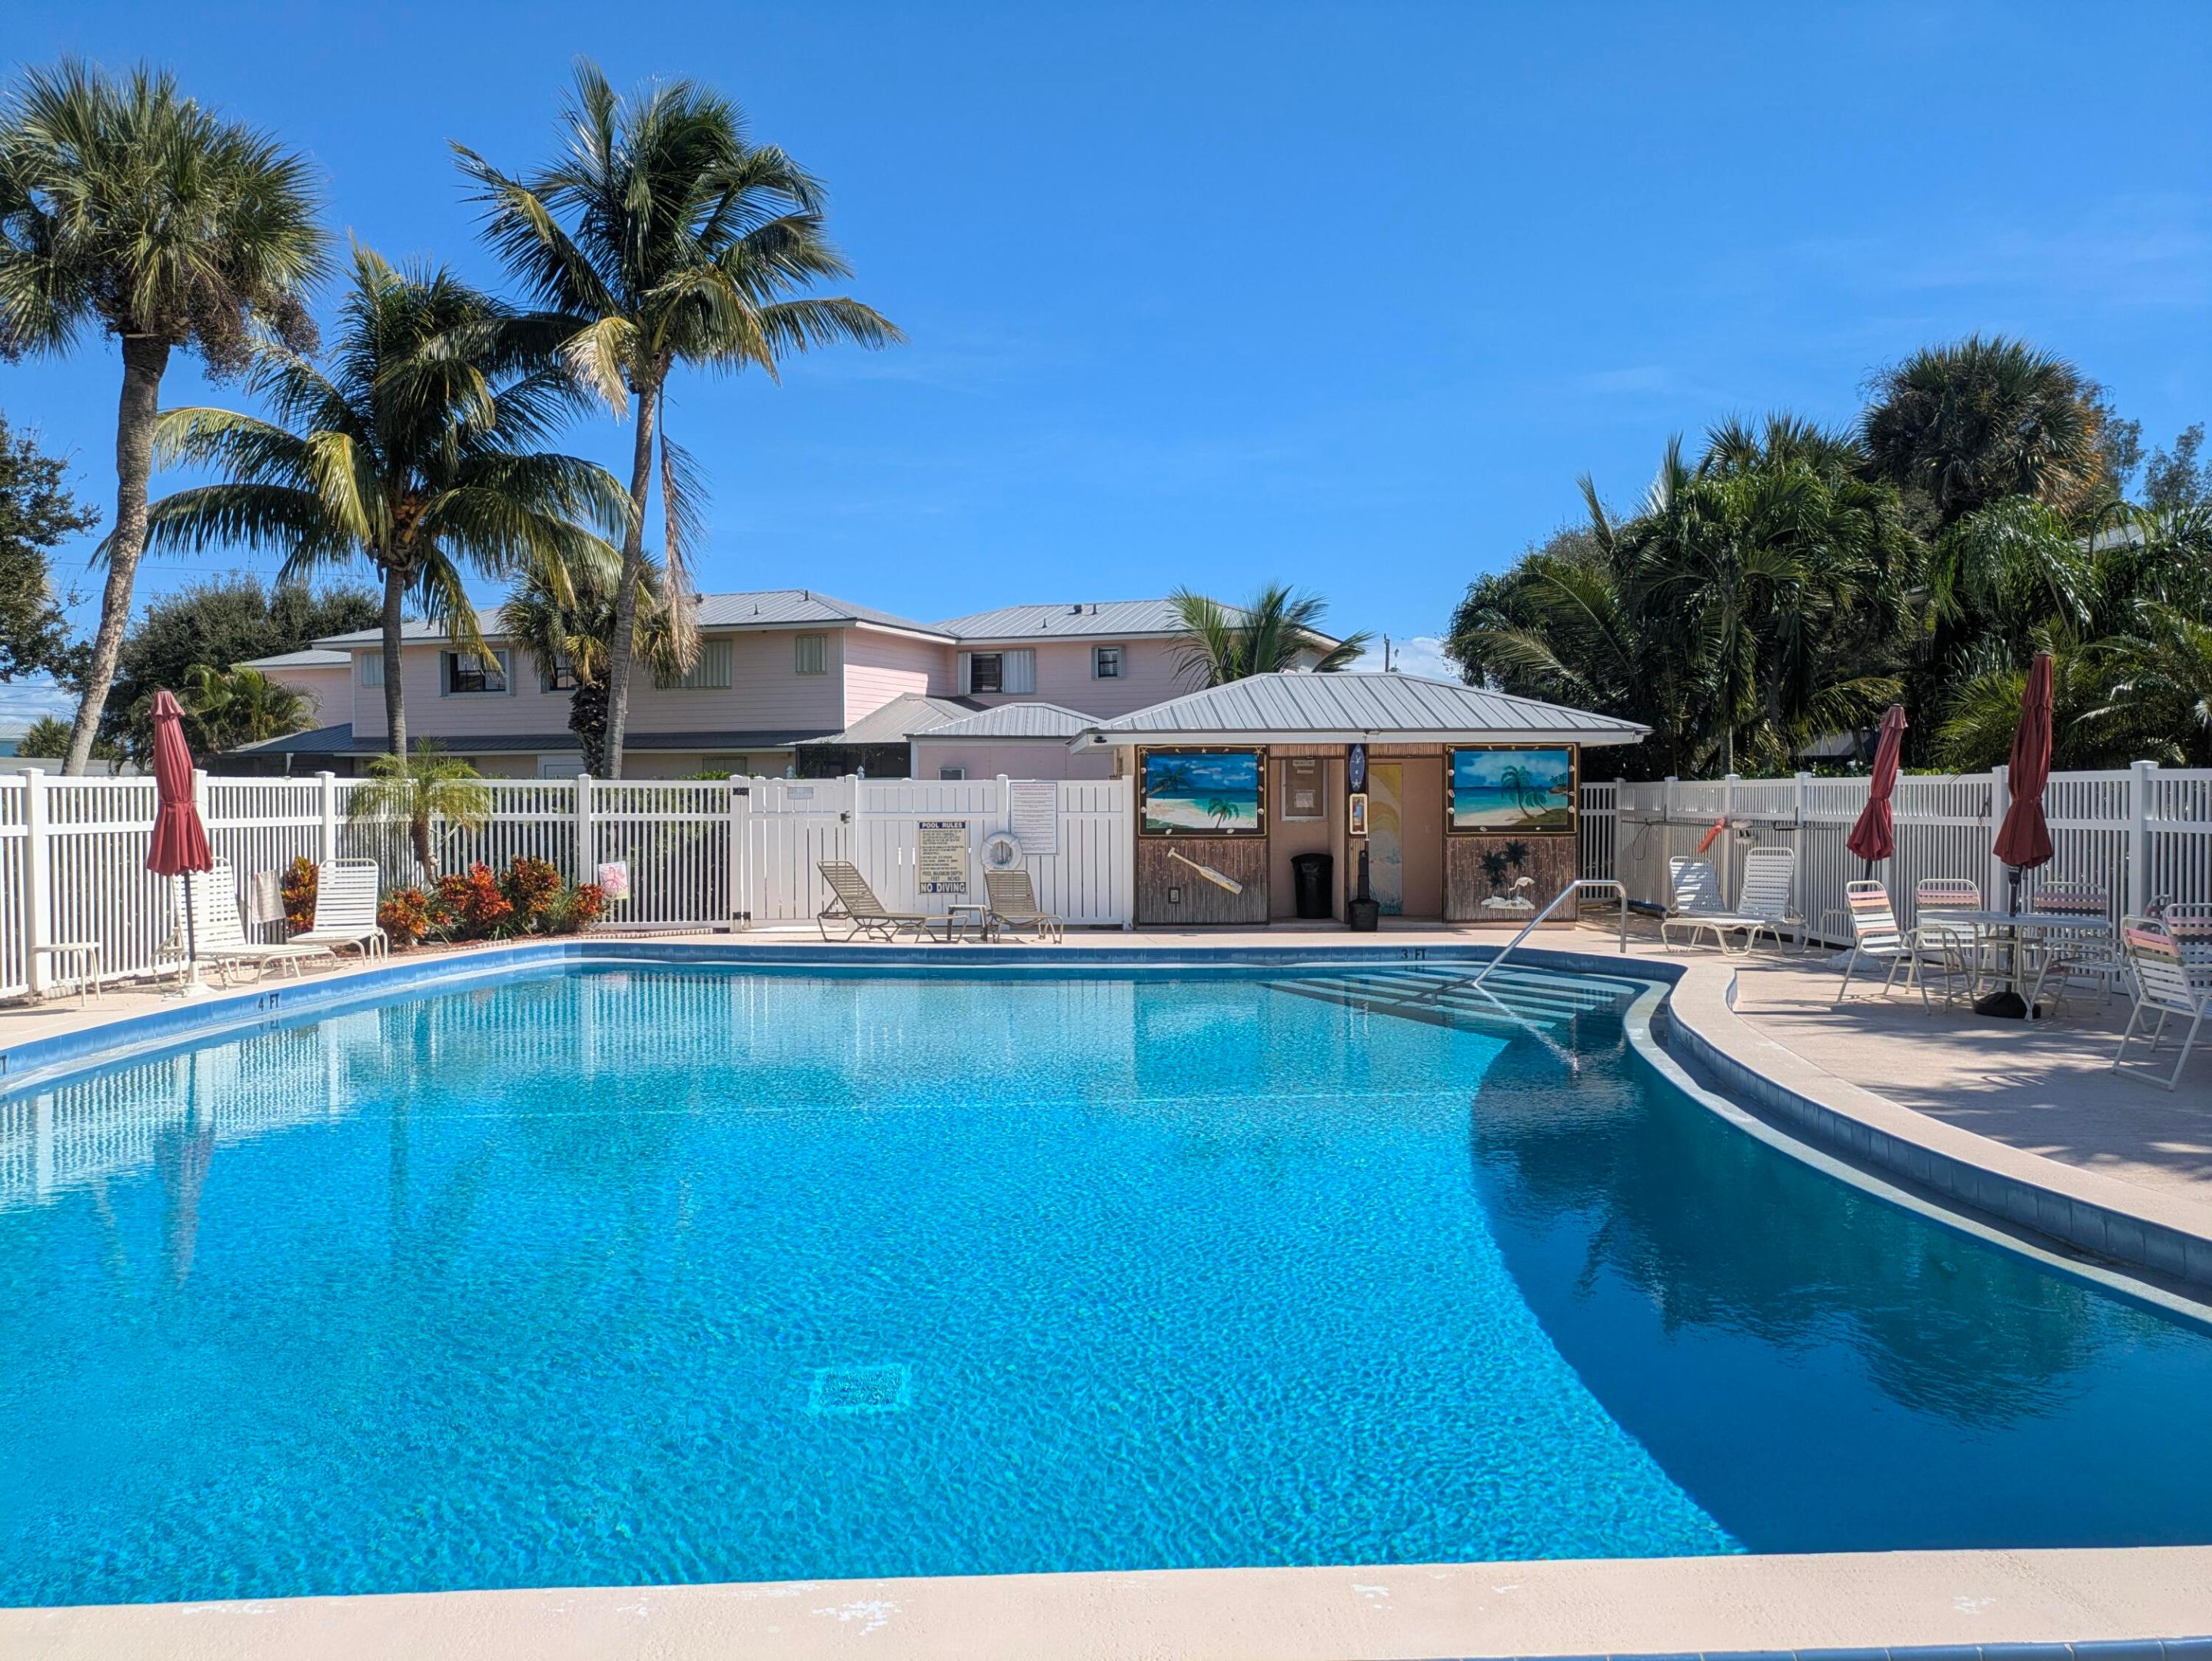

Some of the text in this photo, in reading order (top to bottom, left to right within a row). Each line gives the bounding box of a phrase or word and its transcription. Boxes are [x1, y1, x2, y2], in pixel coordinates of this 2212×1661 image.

[920, 883, 966, 893] NO DIVING
[1401, 948, 1426, 960] 3 FT
[258, 993, 279, 1011] 4 FT
[0, 1054, 7, 1074] T
